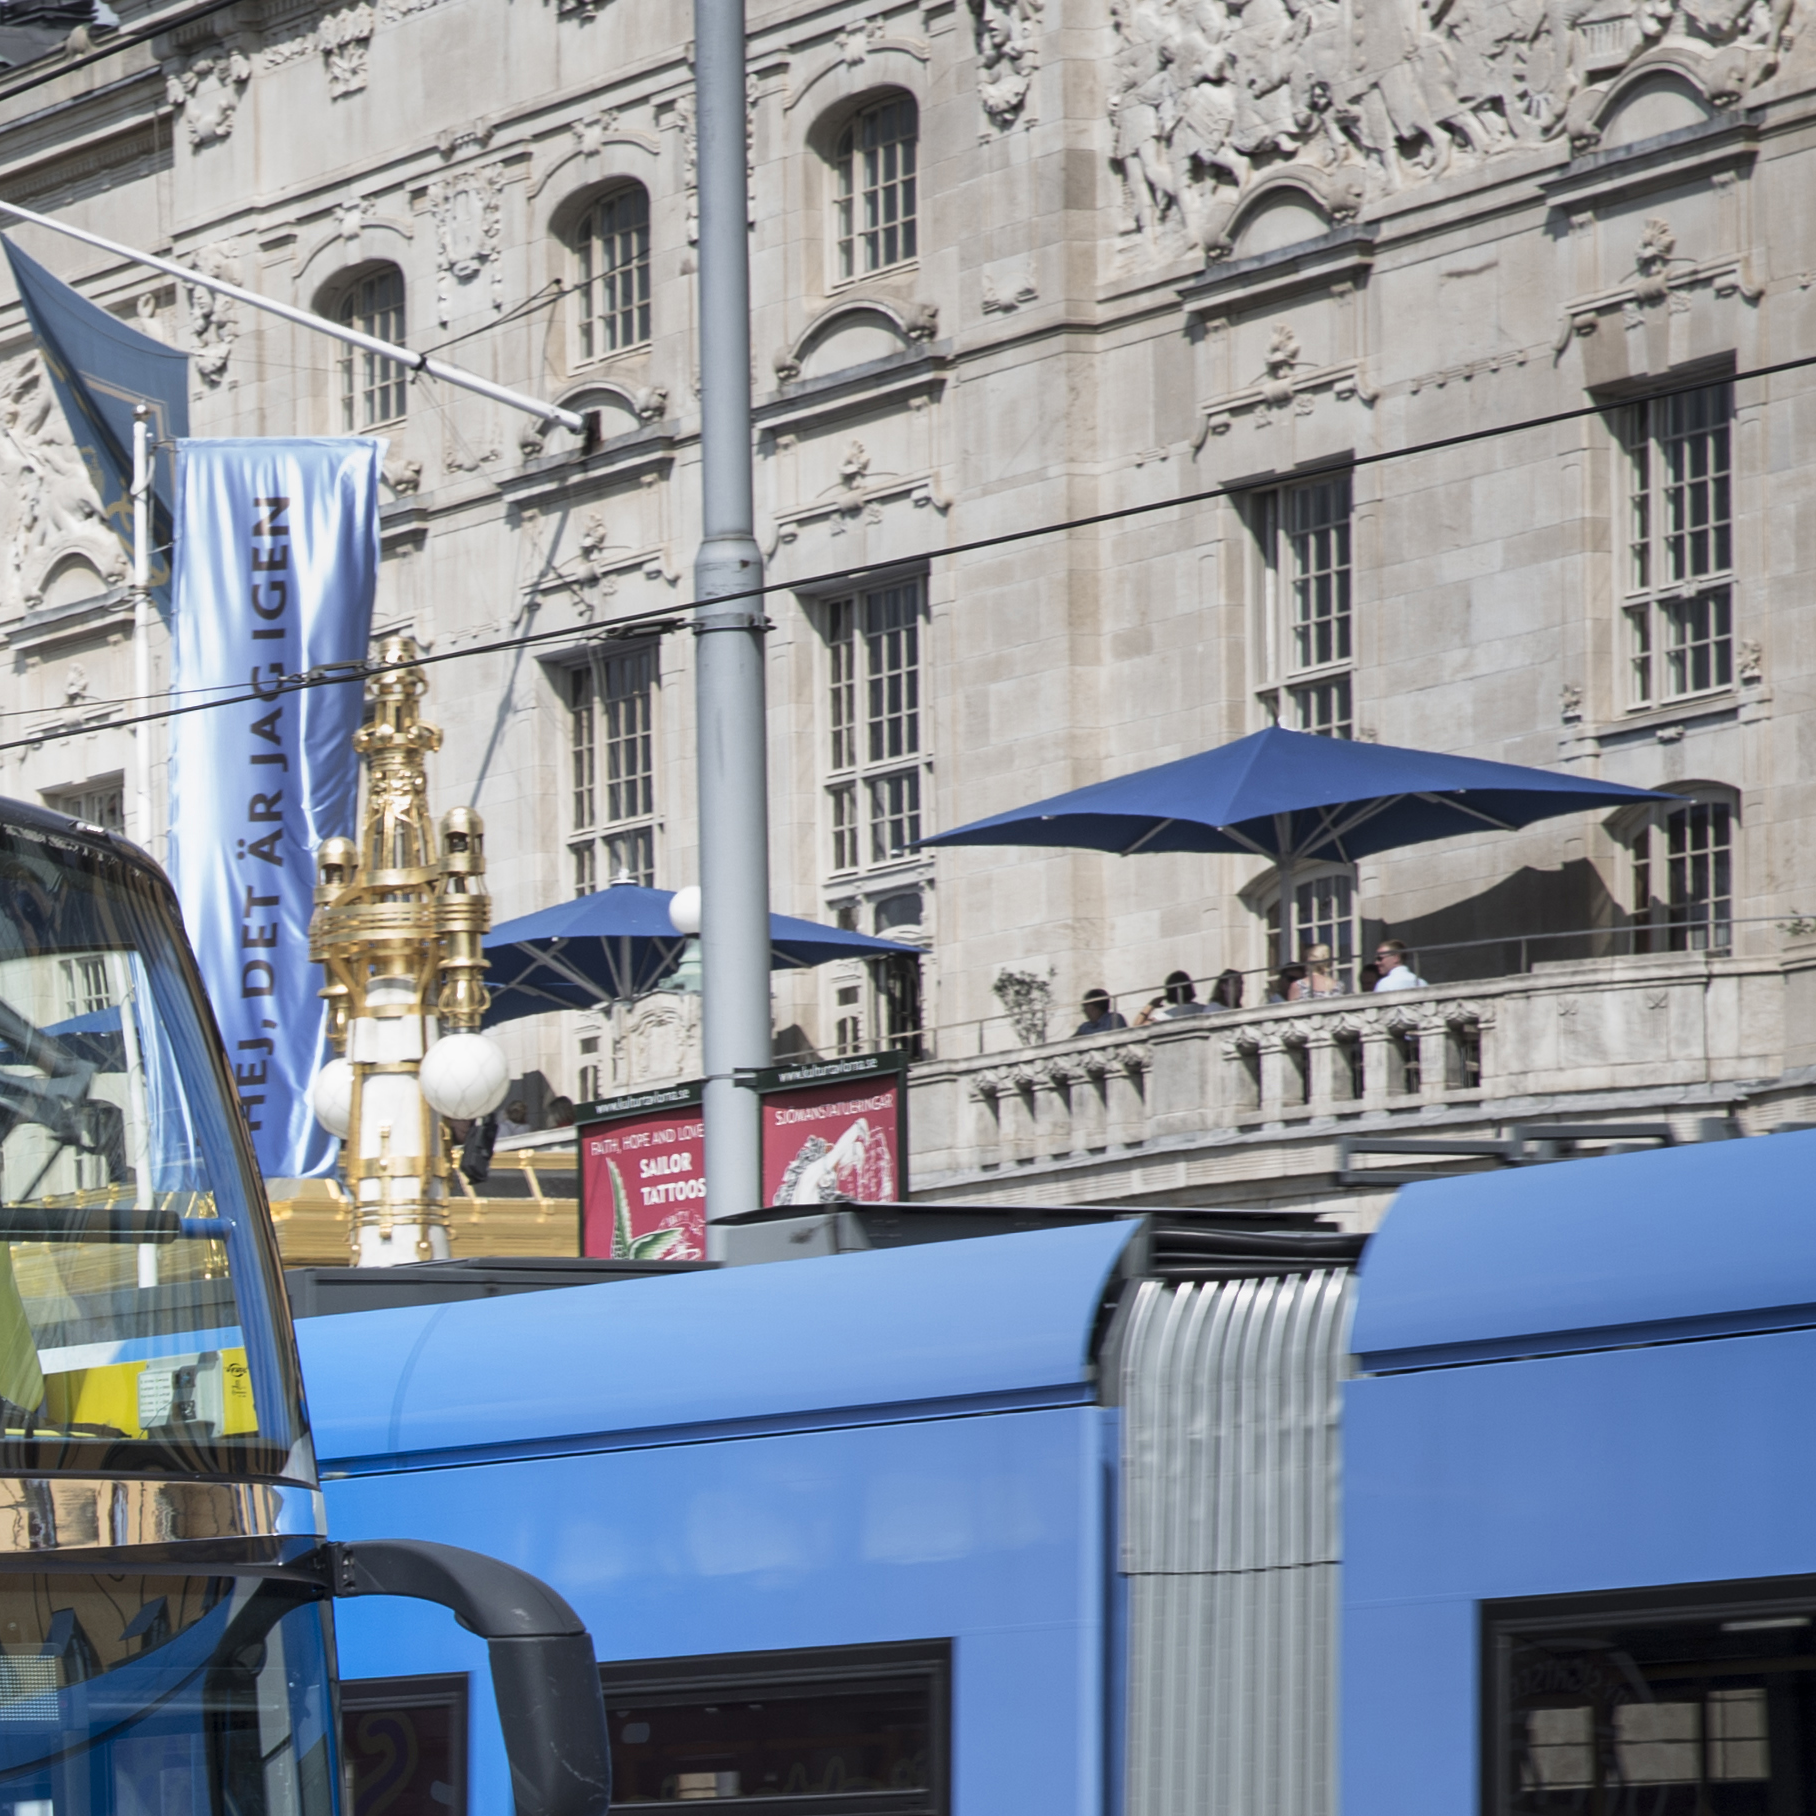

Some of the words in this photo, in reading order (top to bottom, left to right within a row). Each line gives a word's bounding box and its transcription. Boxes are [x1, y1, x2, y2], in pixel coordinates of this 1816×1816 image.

[251, 496, 291, 641] IGEN
[248, 662, 290, 774] JAG
[236, 788, 285, 868] ÄR
[240, 884, 281, 999] DET
[590, 1137, 622, 1157] FAITH,
[622, 1132, 651, 1150] HOPE
[652, 1128, 677, 1146] AND
[677, 1122, 706, 1142] LOVE
[639, 1151, 693, 1179] SAILOR
[640, 1177, 707, 1206] TATTOOS
